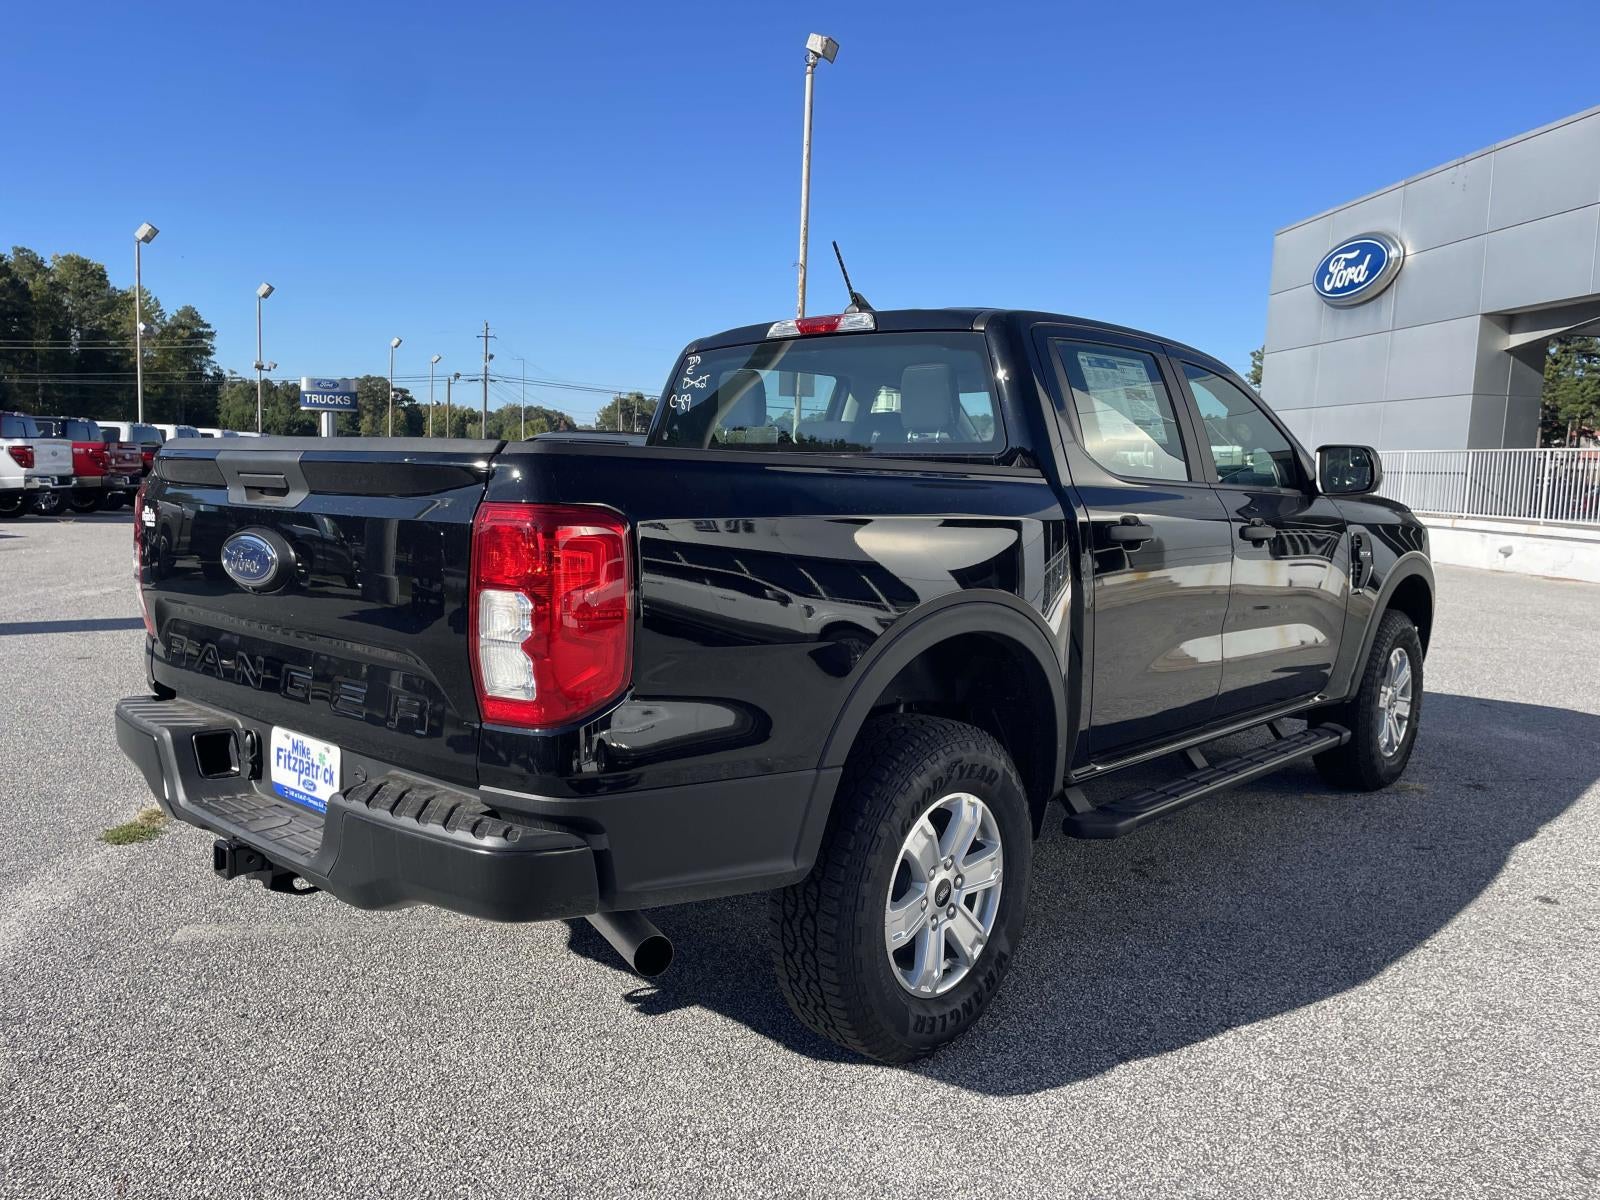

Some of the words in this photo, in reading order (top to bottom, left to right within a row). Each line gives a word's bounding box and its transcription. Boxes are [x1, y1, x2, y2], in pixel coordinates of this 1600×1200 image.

[1324, 249, 1371, 291] Ford
[304, 393, 351, 405] TRUCKS
[228, 544, 261, 574] Ford
[167, 631, 431, 737] RANGER
[276, 746, 335, 788] Fitzpatrick
[291, 738, 311, 760] Mike
[899, 757, 1000, 838] GOODYEAR
[912, 948, 1009, 1036] WRANGLER
